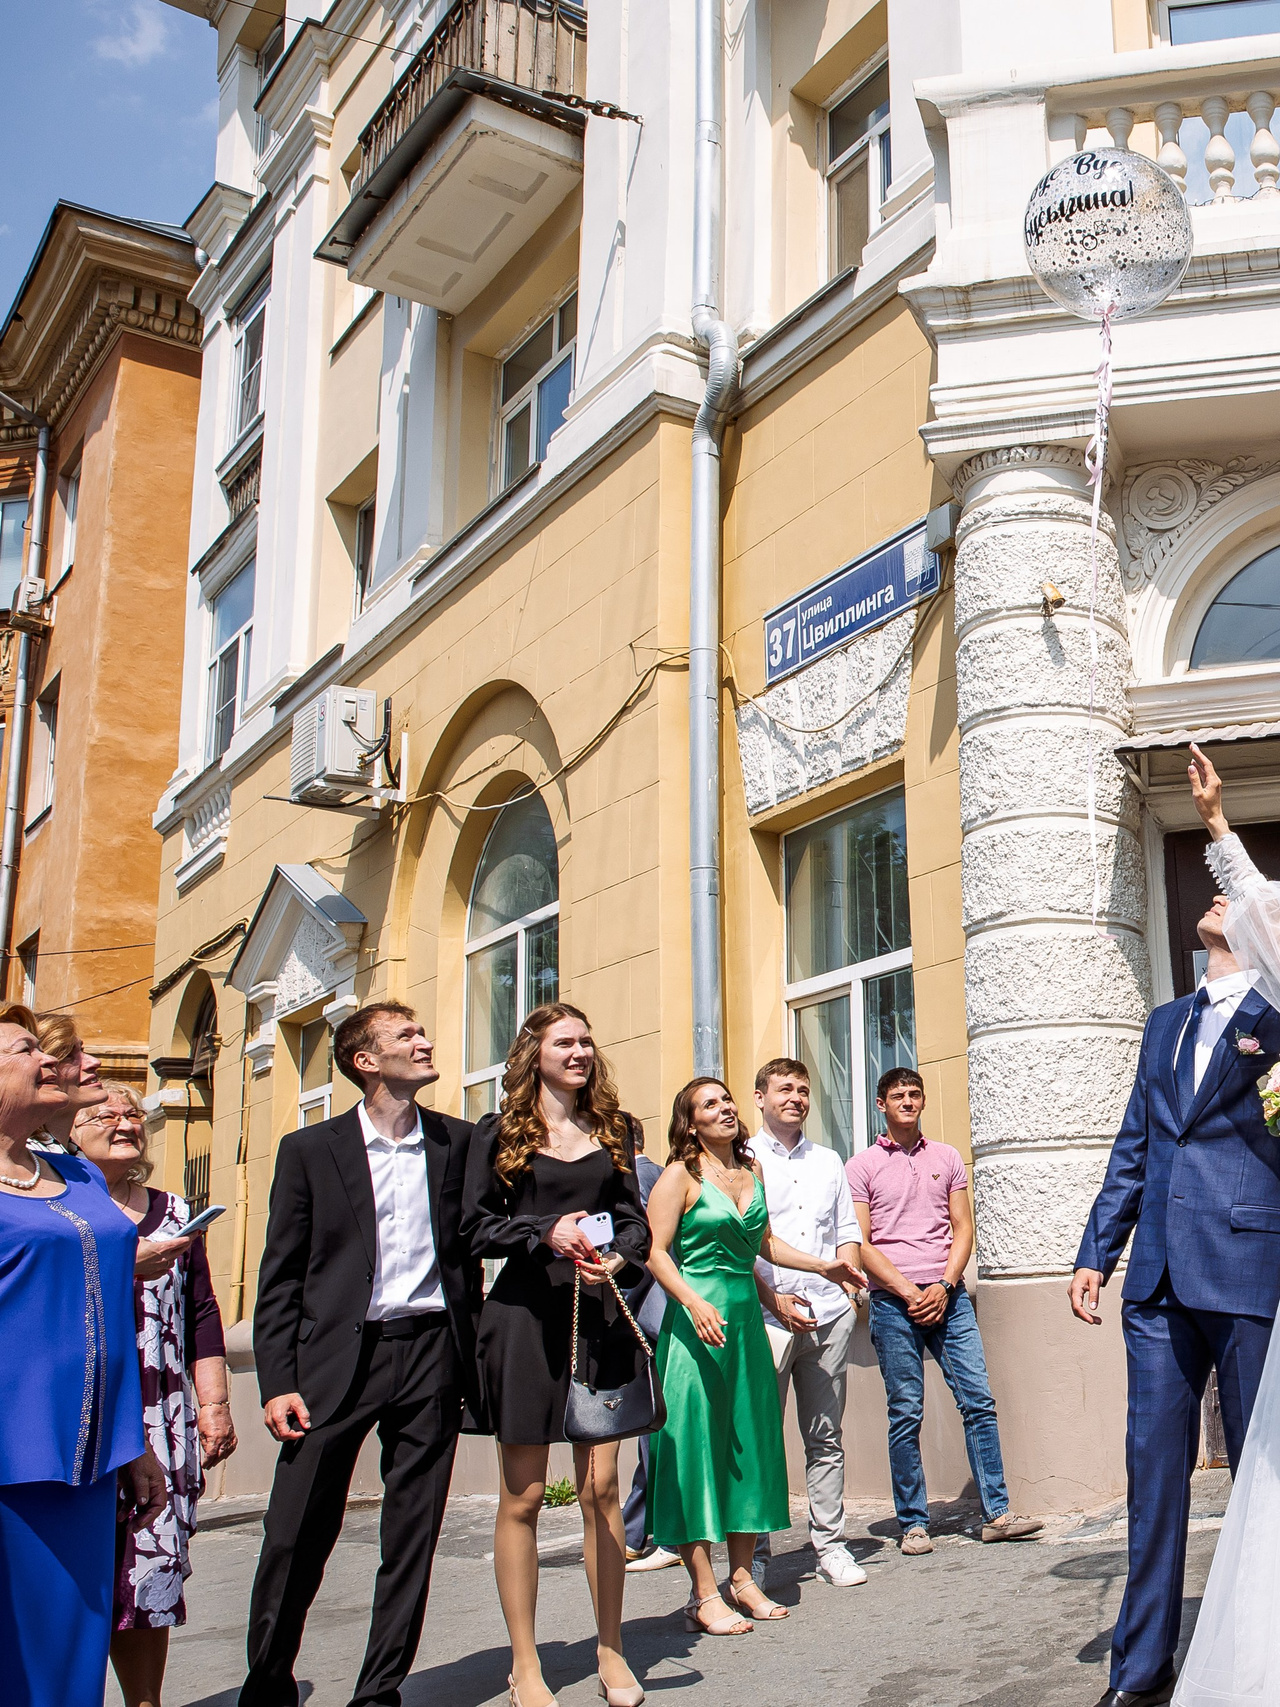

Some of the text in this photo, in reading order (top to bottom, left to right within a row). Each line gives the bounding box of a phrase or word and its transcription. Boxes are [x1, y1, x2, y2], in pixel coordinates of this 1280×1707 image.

[801, 595, 833, 626] улица
[802, 584, 895, 651] Цвиллинга
[769, 617, 797, 668] 37
